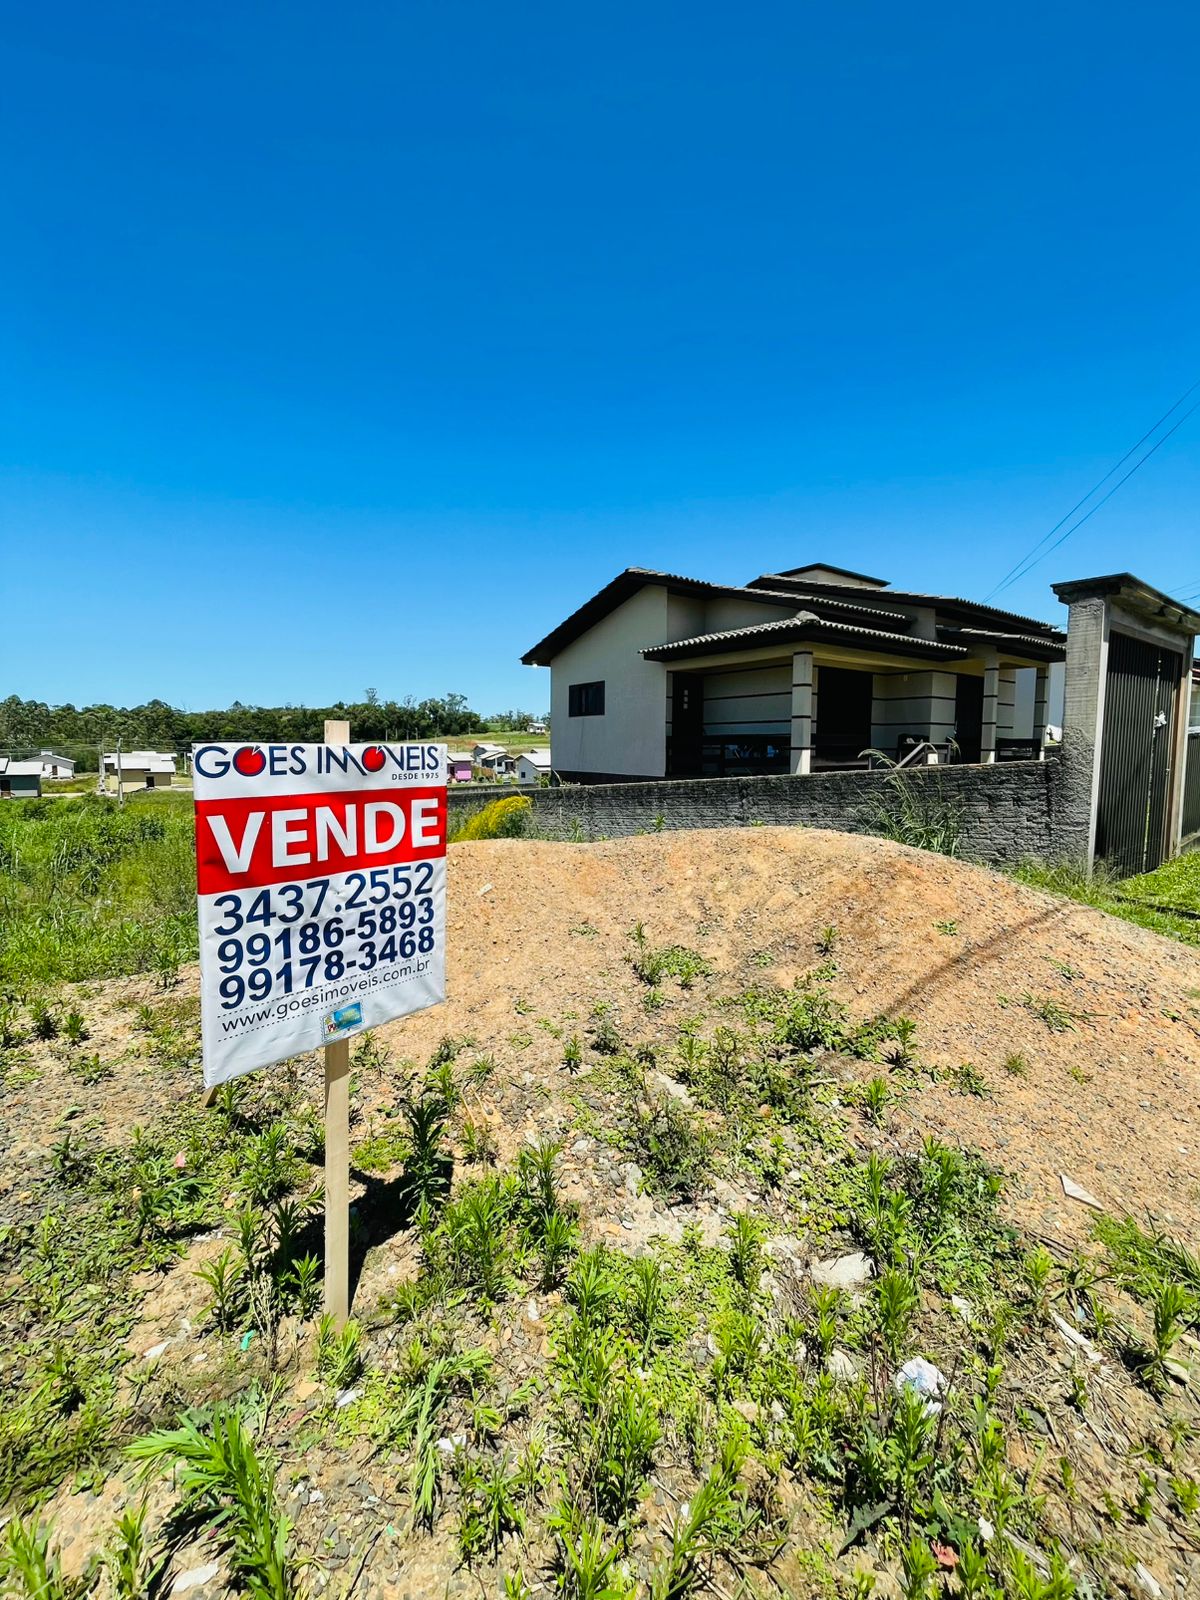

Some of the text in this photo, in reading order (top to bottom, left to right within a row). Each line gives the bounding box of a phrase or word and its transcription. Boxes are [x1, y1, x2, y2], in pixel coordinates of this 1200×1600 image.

[391, 772, 439, 781] DESDE 1975
[206, 798, 440, 874] VENDE
[213, 862, 434, 936] 3437.2552
[217, 897, 435, 974] 99186-5893
[219, 926, 435, 1010] 99178-3468
[221, 958, 431, 1032] www.goesimoveis.com.br
